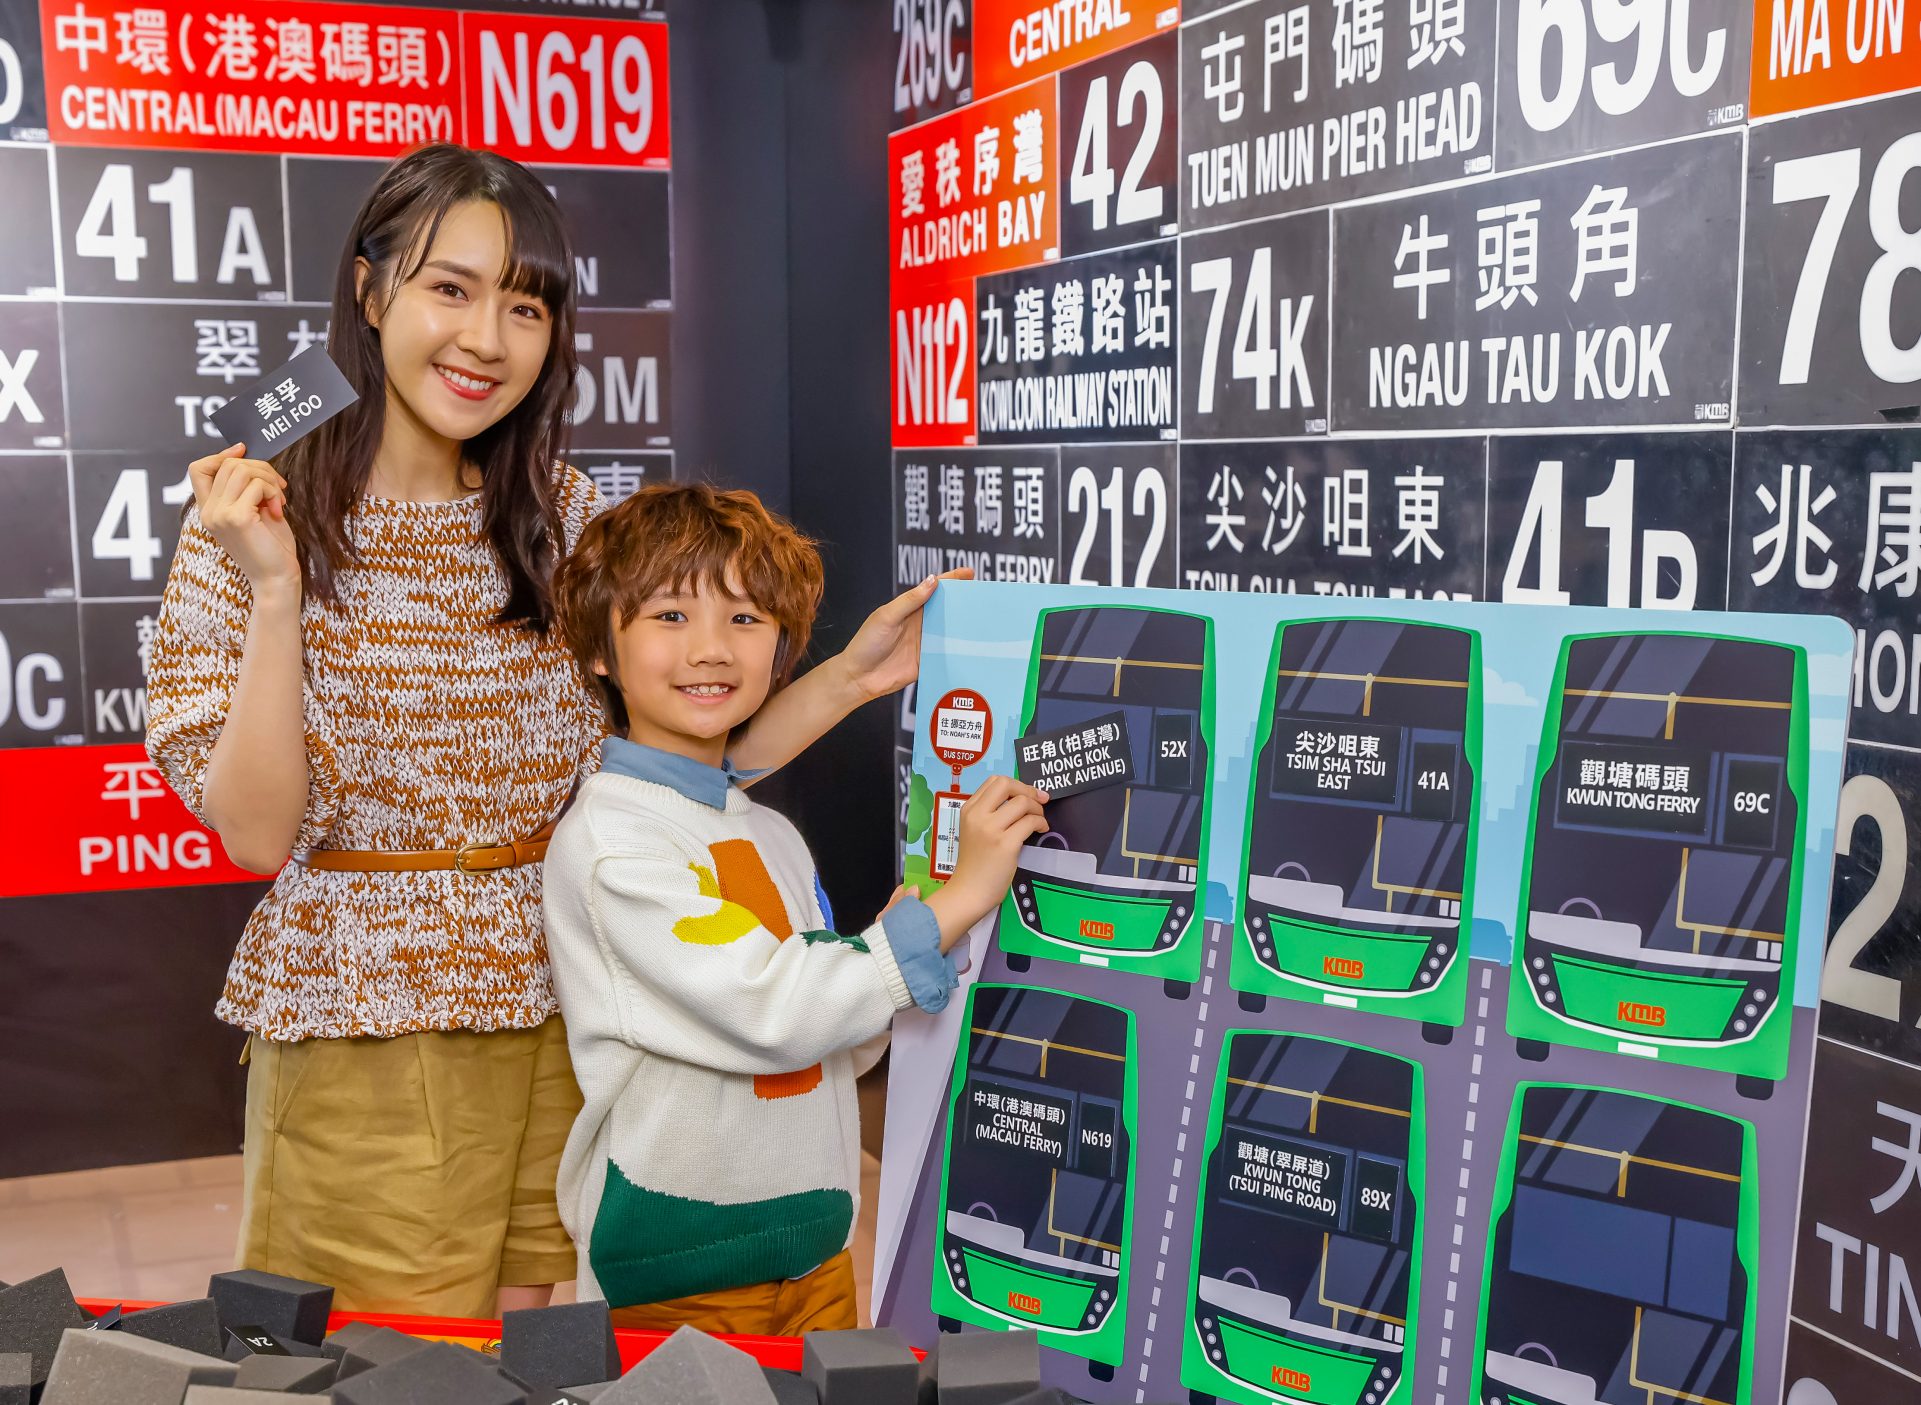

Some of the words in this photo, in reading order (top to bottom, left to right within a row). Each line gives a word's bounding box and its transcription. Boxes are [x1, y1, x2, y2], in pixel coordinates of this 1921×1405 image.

[55, 4, 452, 90] 中環(港澳碼頭)
[893, 0, 965, 112] 269C
[1201, 0, 1466, 123] 屯門碼頭
[1769, 0, 1831, 80] MA
[1517, 0, 1727, 132] 69C
[480, 29, 653, 153] N619
[347, 101, 454, 144] FERRY)
[900, 108, 1044, 218] 愛秩序灣
[1070, 61, 1164, 231] 42
[1188, 141, 1248, 209] TUEN
[1255, 123, 1315, 196] MUN
[1322, 105, 1386, 181] PIER
[1396, 81, 1482, 166] HEAD
[75, 163, 273, 285] 41A
[900, 208, 987, 269] ALDRICH
[997, 191, 1046, 246] BAY
[1393, 184, 1639, 320] 牛頭角
[980, 264, 1172, 366] 九龍鐵路站
[1191, 246, 1315, 414] 74K
[896, 297, 968, 426] N112
[1369, 339, 1469, 409] NGAU
[1481, 331, 1561, 405] TAU
[1575, 322, 1673, 401] KOK
[175, 396, 238, 438] TS
[254, 377, 301, 421] 美孚
[261, 415, 292, 442] MEI
[289, 394, 322, 423] FOO
[980, 377, 1044, 432] KOWLOON
[1046, 371, 1106, 429] RAILWAY
[1107, 365, 1172, 428] STATION
[904, 464, 1044, 539] 觀塘碼頭
[1206, 465, 1445, 564] 尖沙咀東
[1068, 466, 1167, 588] 212
[944, 750, 955, 759] BUS
[957, 752, 974, 761] STOP
[1022, 722, 1120, 763] 旺角(柏景灣)
[1041, 753, 1083, 776] MONG
[1086, 746, 1111, 765] KOK
[1161, 740, 1187, 758] 52X
[1295, 730, 1380, 759] 尖沙咀東
[1033, 773, 1072, 792] (PARK
[1075, 758, 1126, 784] AVENUE)
[1286, 753, 1319, 771] TSIM
[1322, 757, 1351, 773] SHA
[1355, 759, 1386, 776] TSUI
[1317, 773, 1351, 790] EAST
[1418, 771, 1449, 790] 41A
[1580, 759, 1690, 793] 觀塘碼頭
[101, 762, 165, 820] 平
[1566, 788, 1614, 808] KWUN
[1614, 791, 1655, 811] TONG
[1656, 795, 1700, 814] FERRY
[1733, 791, 1770, 814] 69C
[79, 830, 212, 876] PING
[1821, 774, 1921, 1029] 2
[1079, 919, 1114, 941] KMB
[1323, 956, 1364, 979] KMB
[1618, 1001, 1665, 1027] KMB
[974, 1090, 1066, 1125] 中環(港澳碼頭)
[993, 1113, 1043, 1137] CENTRAL
[975, 1123, 1021, 1146] (MACAU
[1024, 1134, 1062, 1158] FERRY)
[1082, 1129, 1112, 1148] N619
[1238, 1141, 1330, 1180] 觀塘(翠屏道)
[1243, 1163, 1282, 1184] KWUN
[1286, 1172, 1321, 1194] TONG
[1229, 1174, 1260, 1194] (TSUI
[1263, 1183, 1293, 1203] PING
[1296, 1191, 1336, 1217] ROAD)
[1360, 1187, 1391, 1211] 89X
[1008, 1291, 1041, 1315] KMB
[1271, 1365, 1311, 1393] KMB
